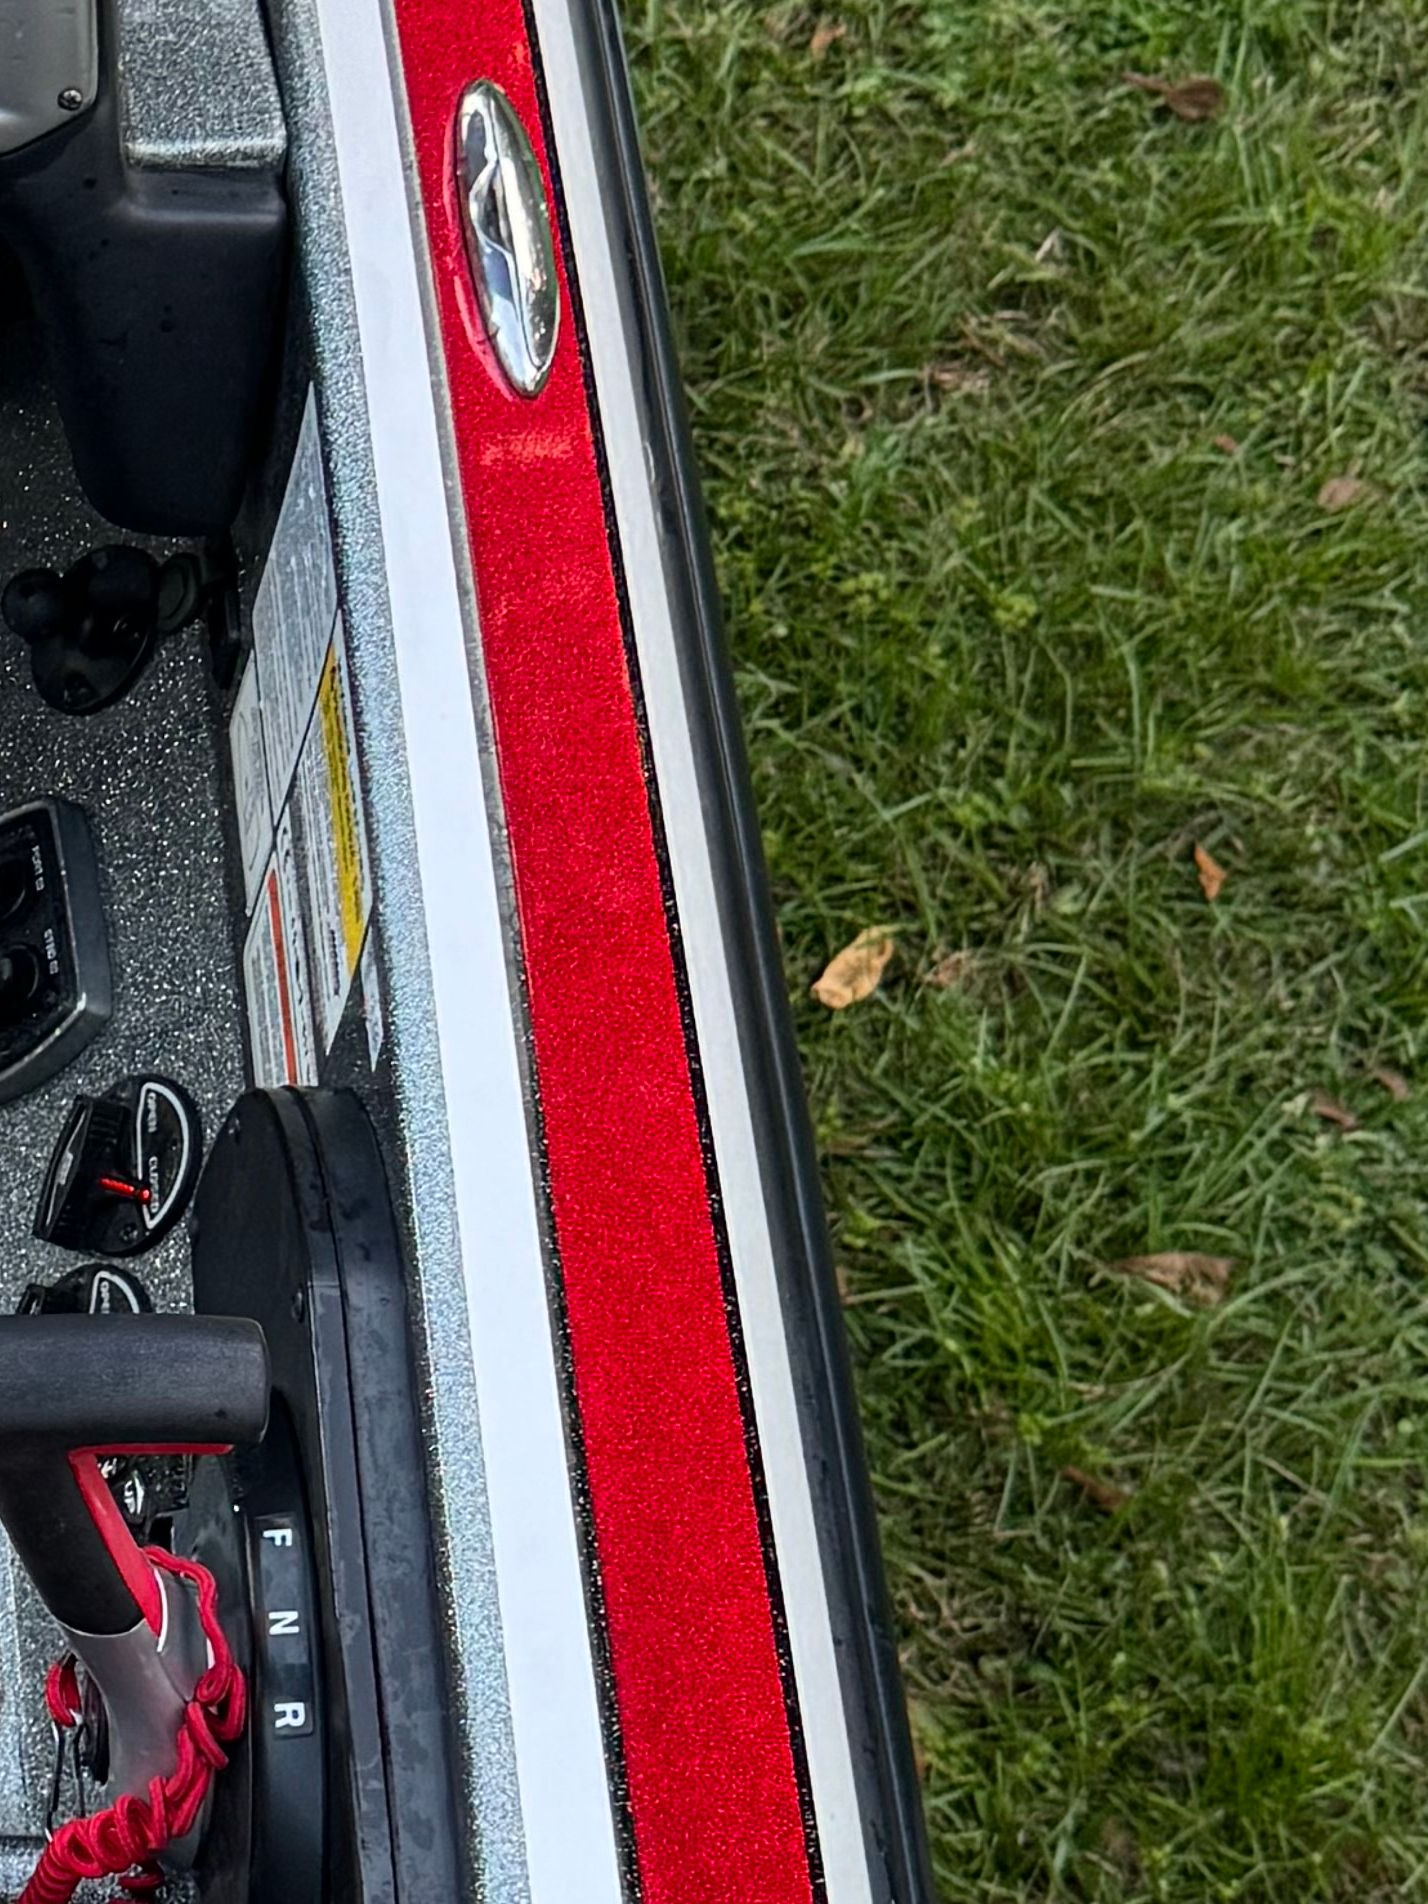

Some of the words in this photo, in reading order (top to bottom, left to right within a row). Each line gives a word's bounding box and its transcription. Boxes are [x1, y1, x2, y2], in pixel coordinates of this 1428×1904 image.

[262, 1528, 293, 1546] F
[268, 1610, 300, 1636] N
[274, 1702, 306, 1728] R
